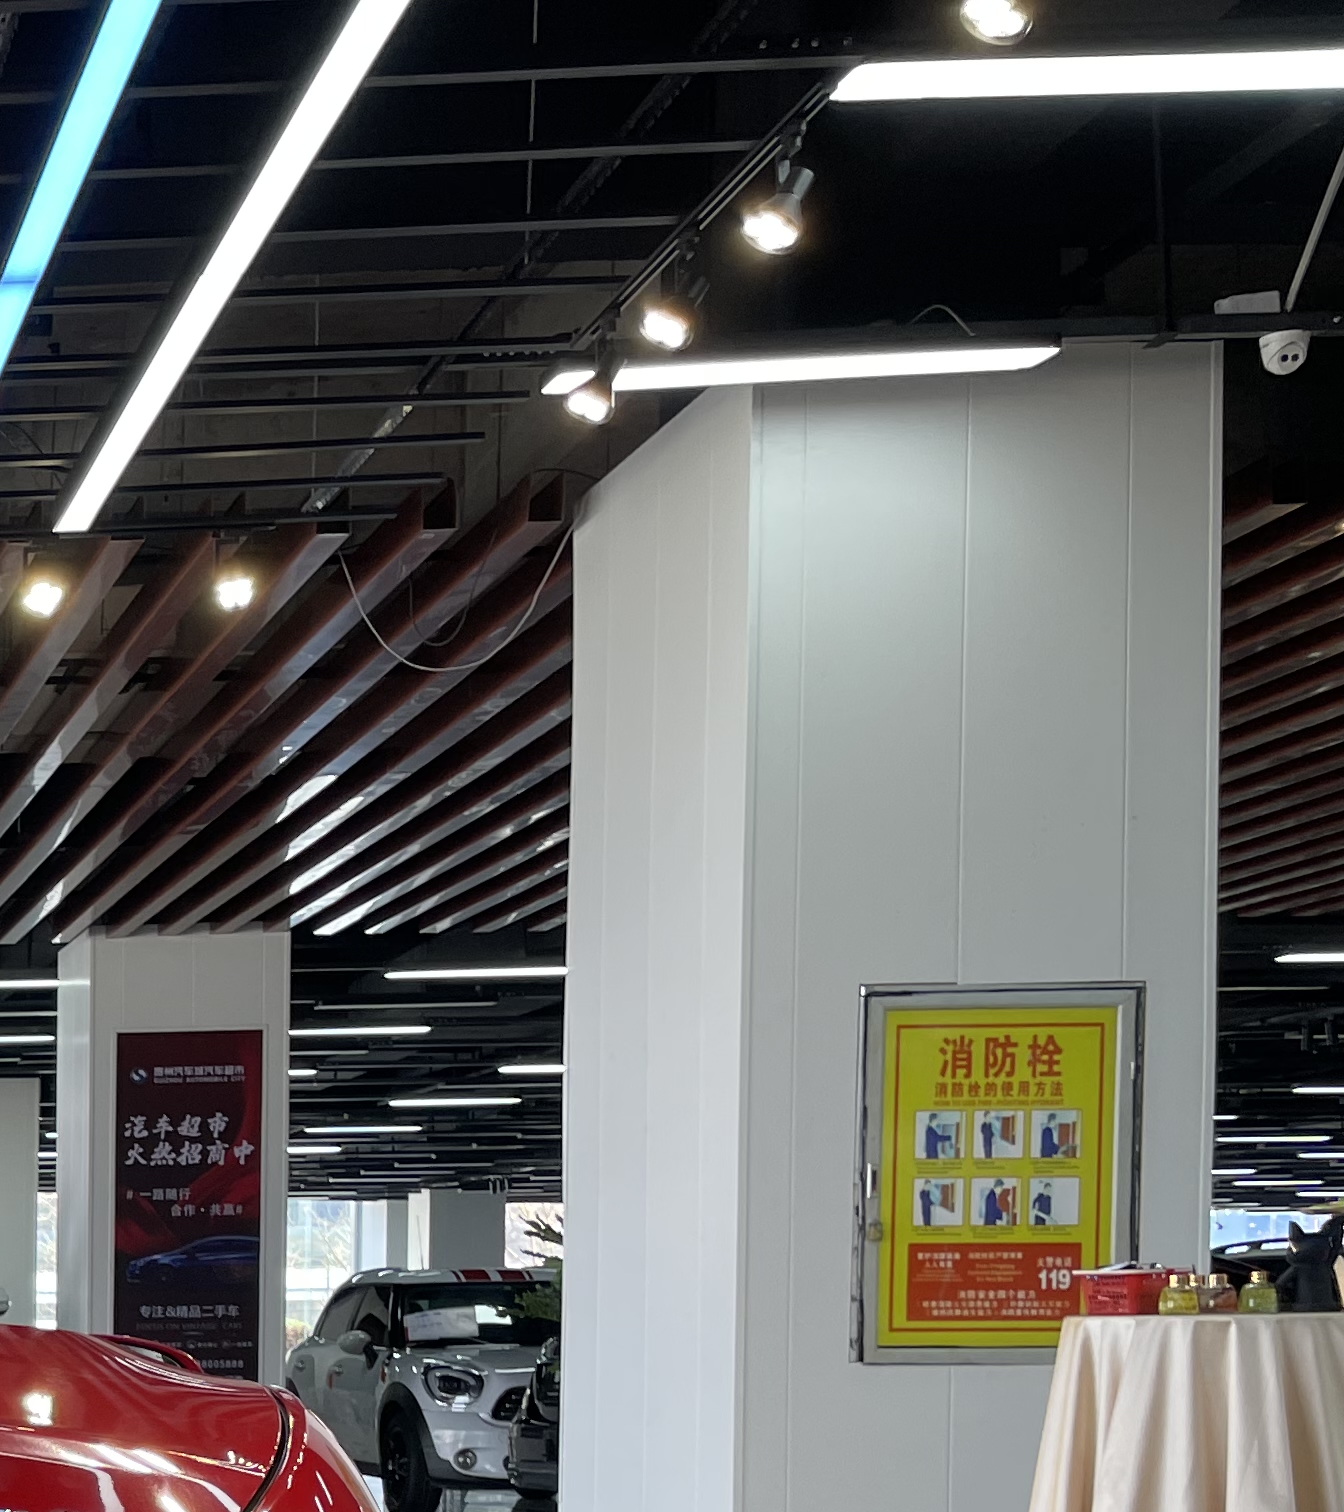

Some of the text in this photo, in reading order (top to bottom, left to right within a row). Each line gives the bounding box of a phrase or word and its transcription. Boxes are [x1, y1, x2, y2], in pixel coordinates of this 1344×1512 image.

[938, 1034, 1064, 1079] 消防栓
[934, 1081, 1064, 1099] 消防栓的使用方法
[124, 1112, 230, 1140] 汽车超市
[124, 1139, 255, 1166] 火热招商中
[1037, 1269, 1072, 1290] 119
